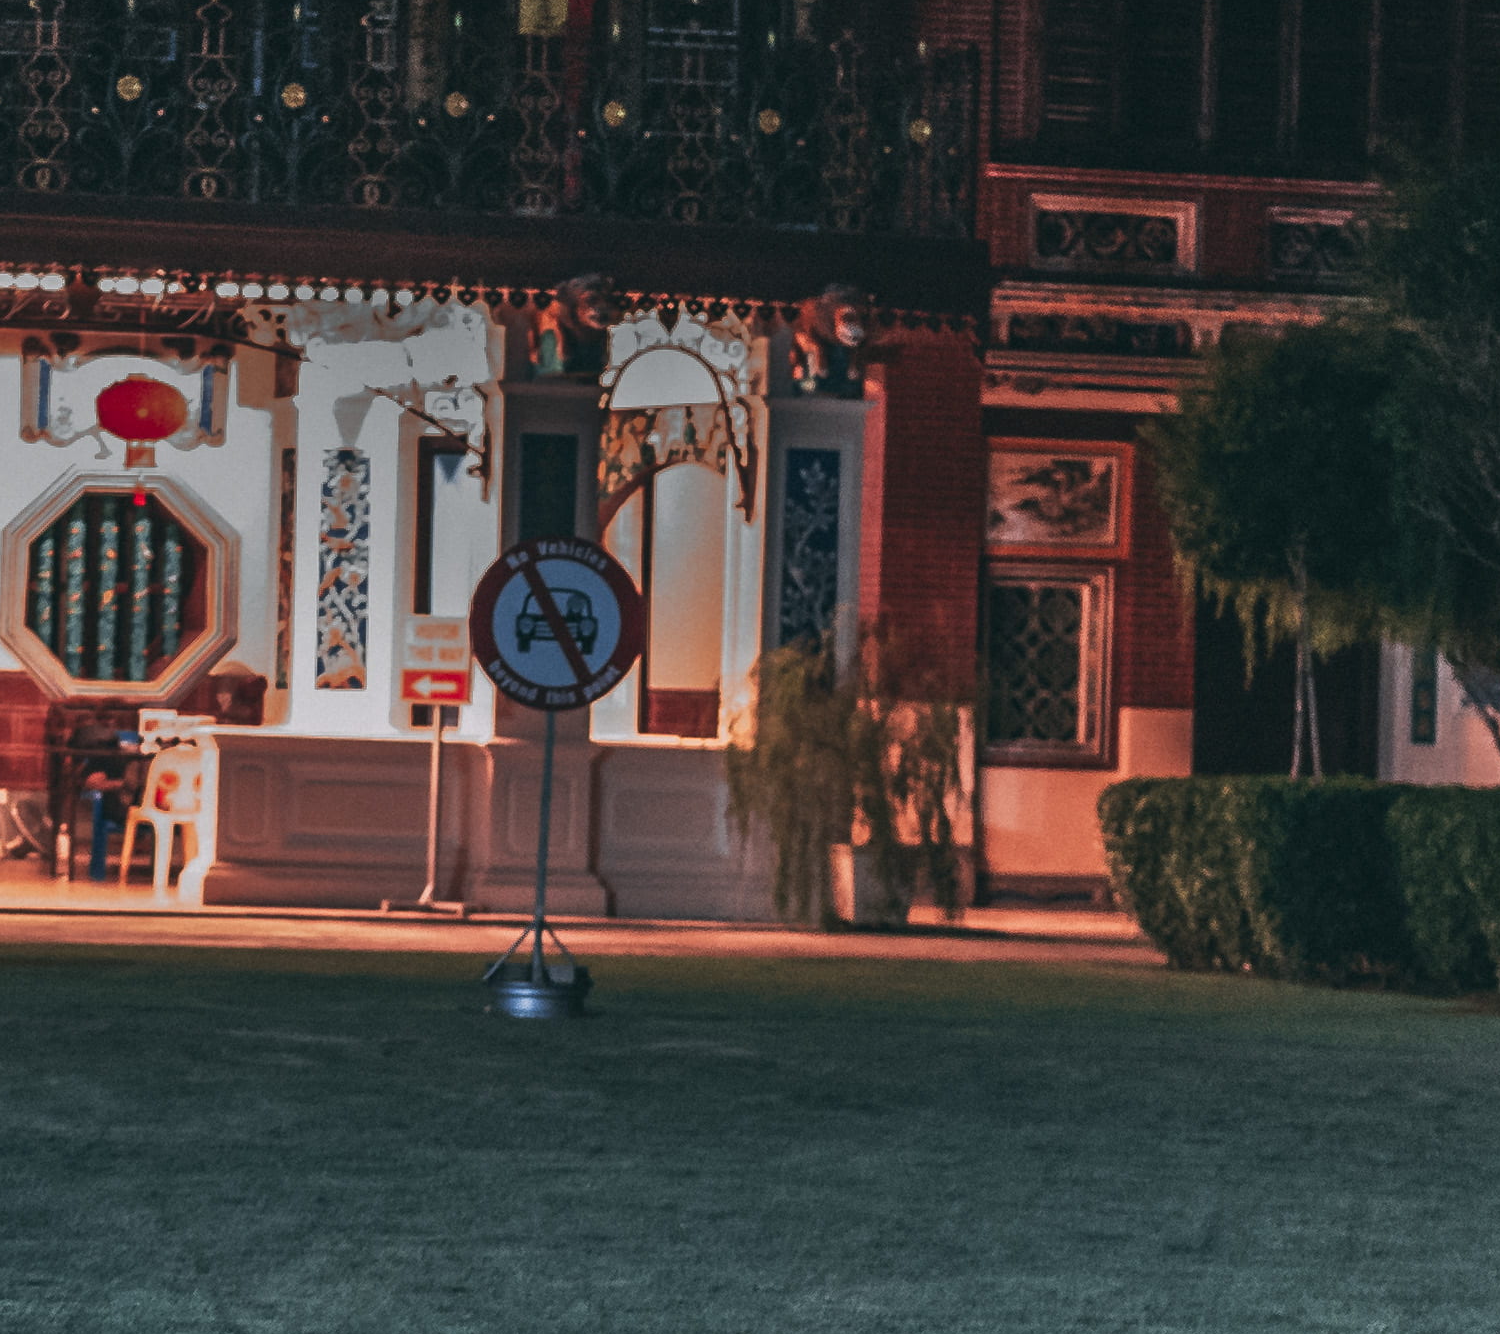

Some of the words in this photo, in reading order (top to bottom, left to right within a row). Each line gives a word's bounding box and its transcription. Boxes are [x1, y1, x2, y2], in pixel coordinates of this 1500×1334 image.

[504, 550, 530, 570] No
[536, 540, 609, 571] Vehicles
[487, 660, 539, 702] beyond
[545, 690, 578, 706] this
[582, 664, 622, 701] point
